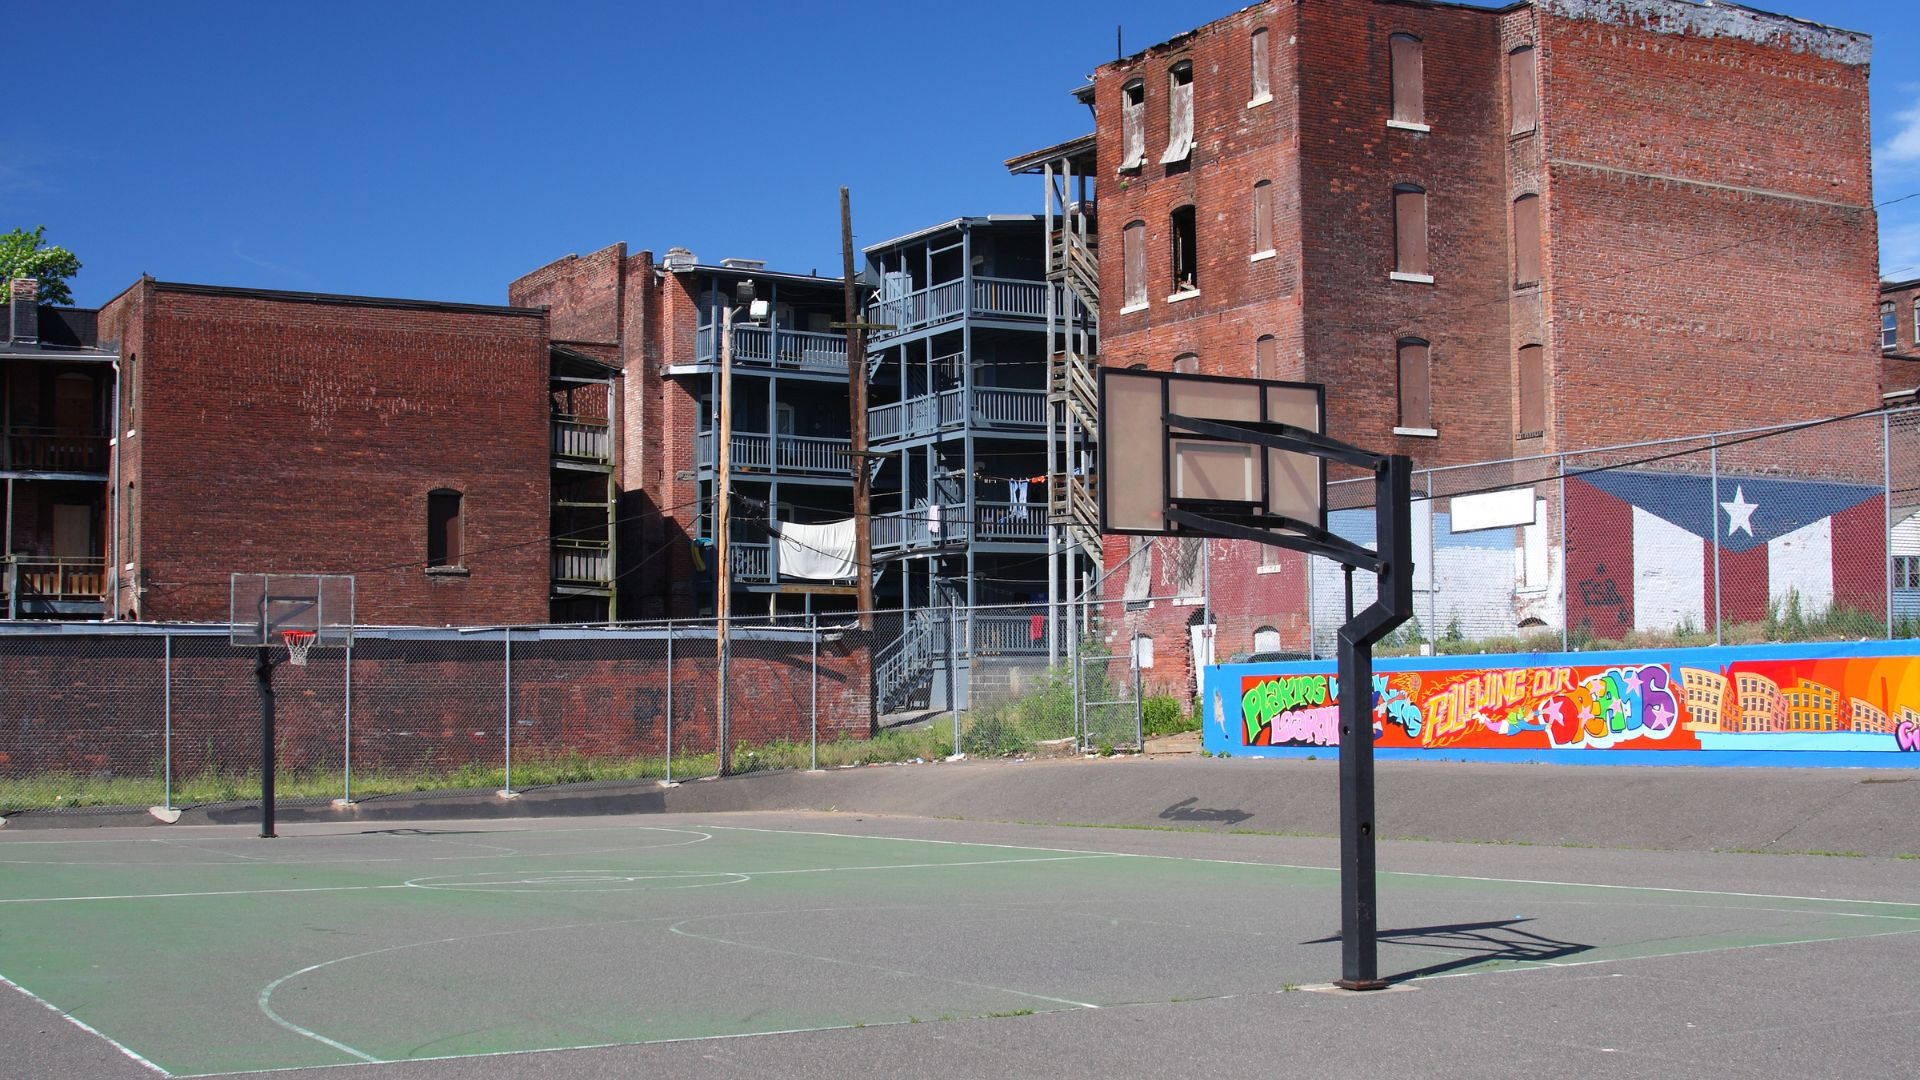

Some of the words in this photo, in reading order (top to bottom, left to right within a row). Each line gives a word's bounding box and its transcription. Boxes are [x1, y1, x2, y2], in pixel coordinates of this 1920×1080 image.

[1423, 669, 1528, 746] FOLLOWING
[1532, 667, 1577, 698] OUR
[1540, 665, 1676, 747] DREAMS
